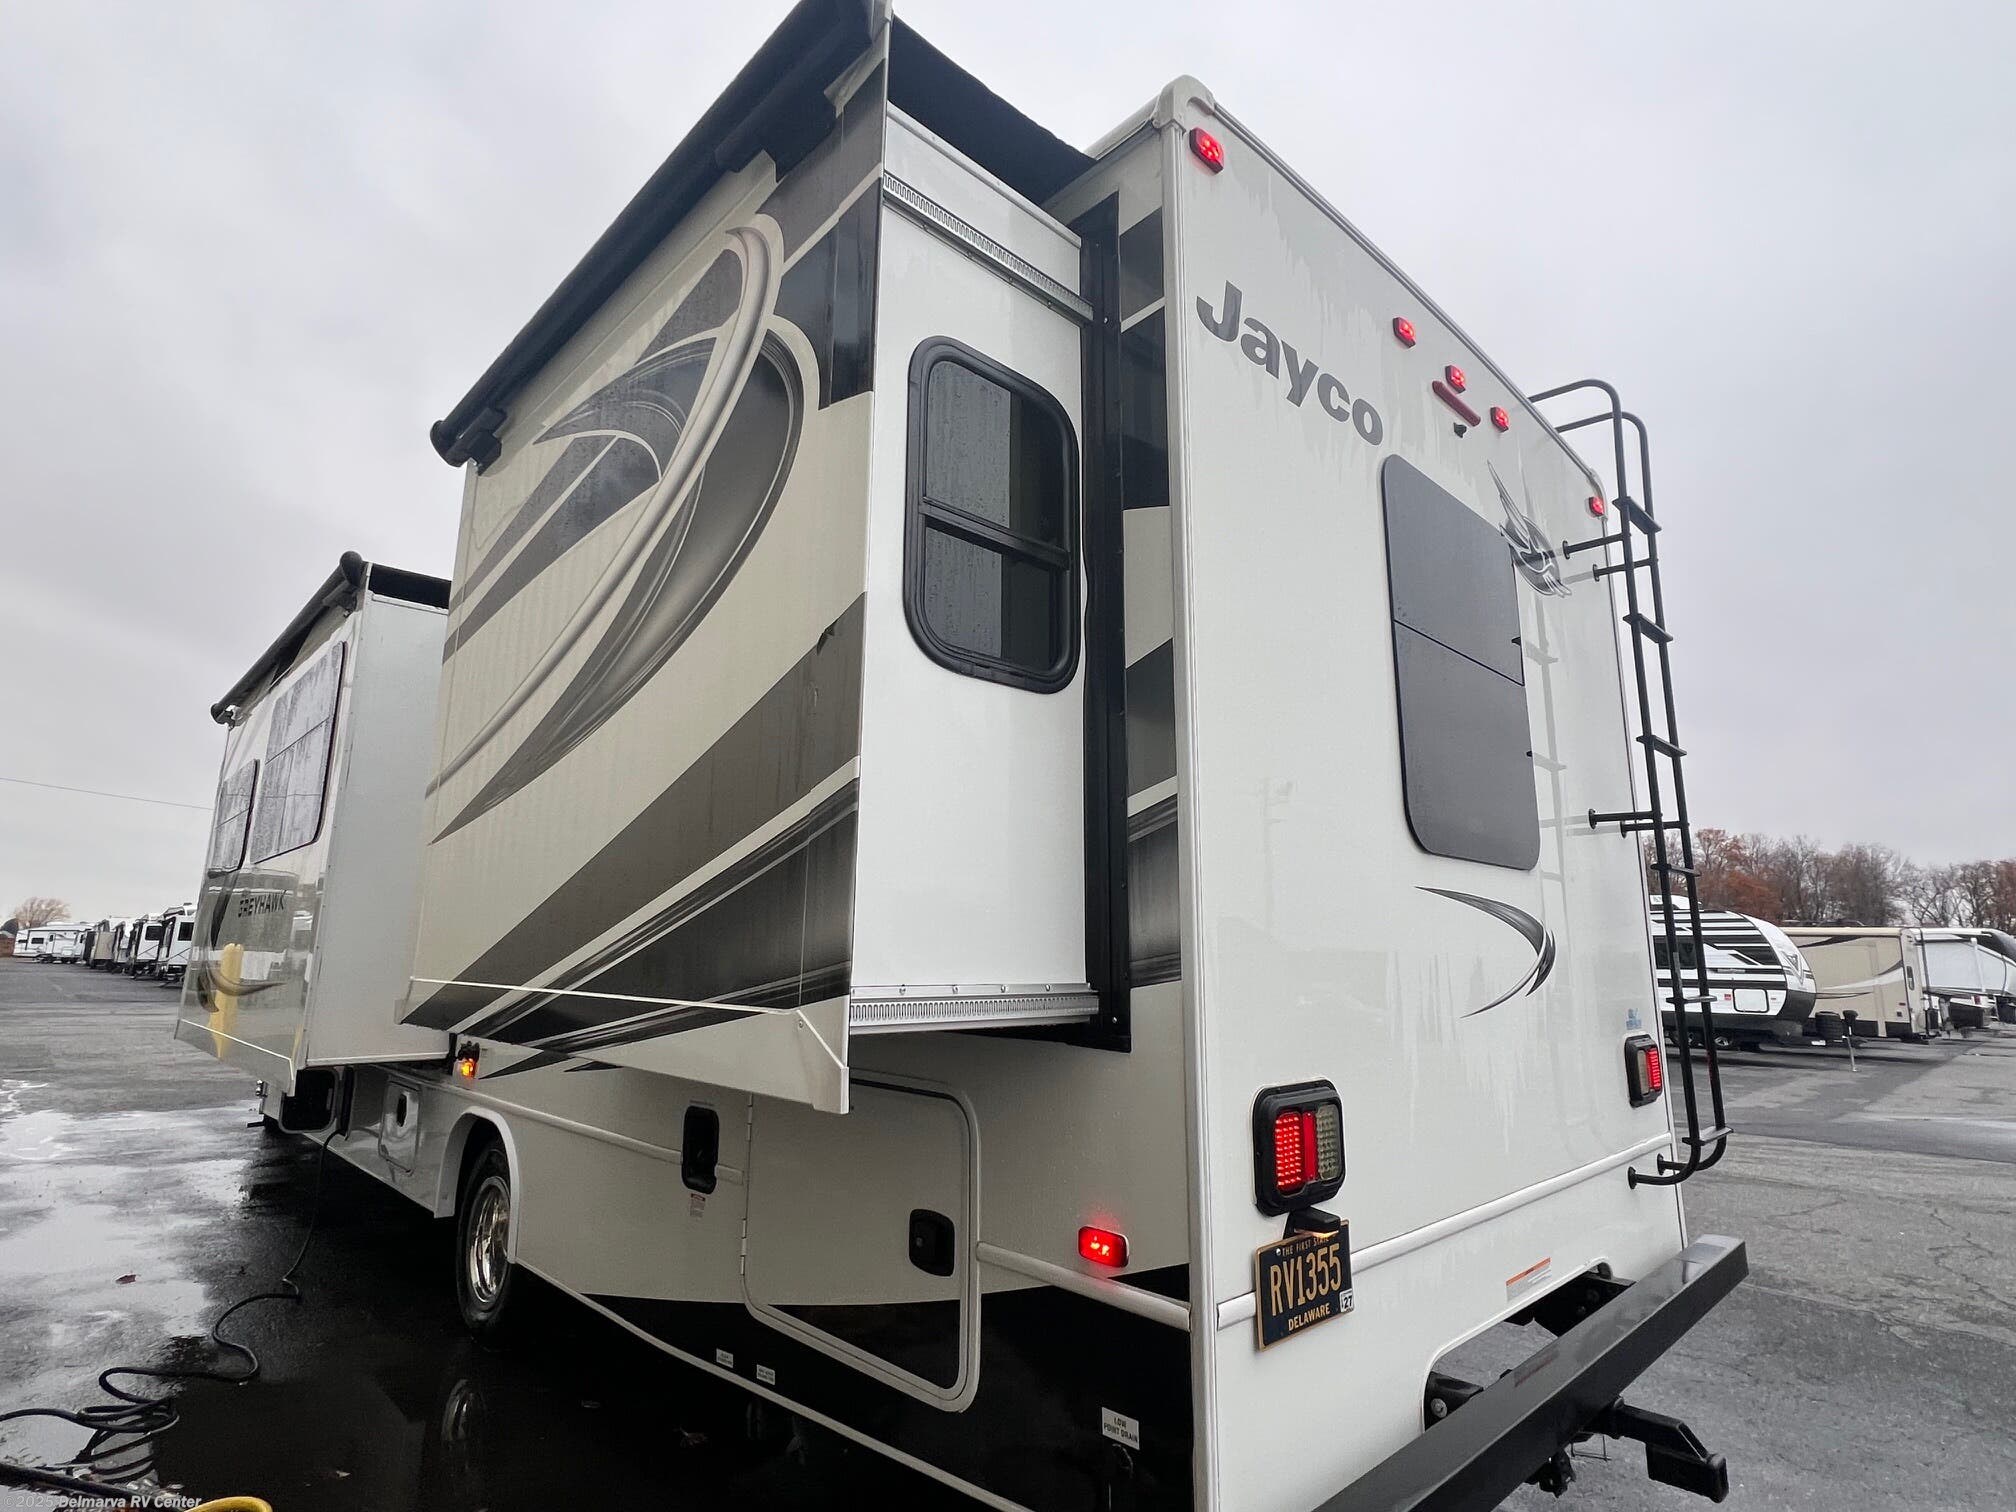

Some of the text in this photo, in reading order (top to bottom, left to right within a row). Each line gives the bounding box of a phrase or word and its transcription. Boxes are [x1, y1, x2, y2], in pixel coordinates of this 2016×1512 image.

[1196, 280, 1383, 446] Jayco
[1282, 1245, 1293, 1256] THE
[1296, 1240, 1311, 1253] FIRST
[1270, 1243, 1342, 1316] RV1355
[1288, 1302, 1331, 1331] DELAWARE
[1114, 1417, 1127, 1429] LOW
